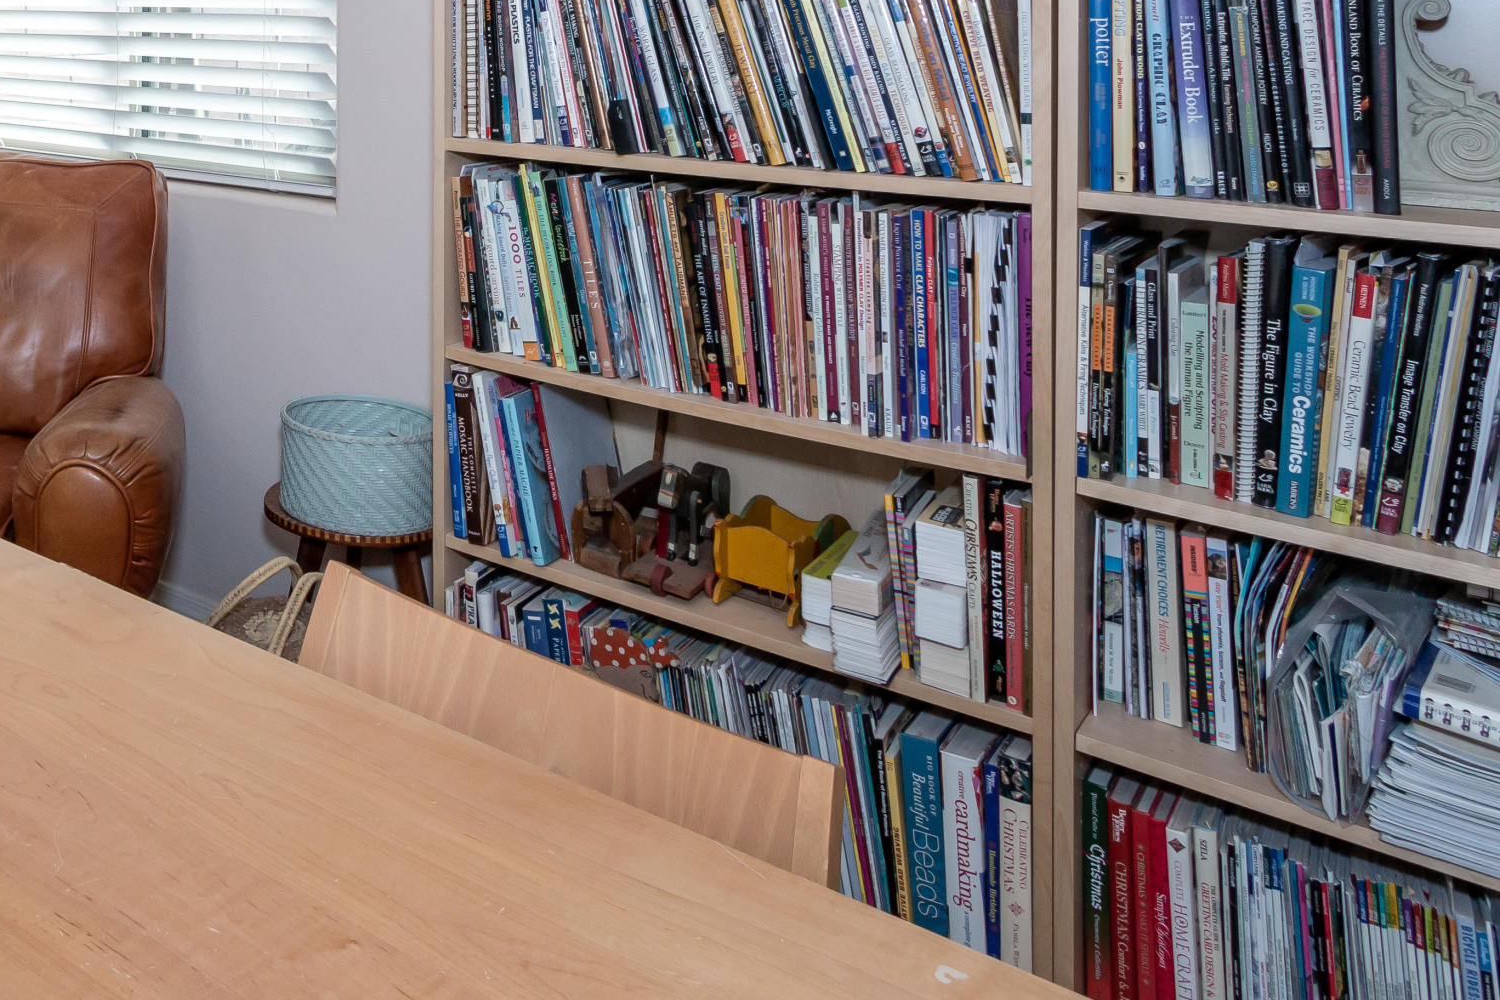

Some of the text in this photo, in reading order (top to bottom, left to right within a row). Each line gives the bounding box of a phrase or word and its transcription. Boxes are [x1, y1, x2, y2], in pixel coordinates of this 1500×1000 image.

[509, 4, 521, 44] PLASTICS
[790, 9, 805, 36] Precious
[800, 37, 812, 54] Metal
[804, 55, 817, 69] Clay
[1090, 17, 1111, 67] potter
[1152, 33, 1168, 126] GRAPHIC CLAY
[1179, 22, 1202, 124] Extruder Book
[485, 243, 502, 306] gourd carving
[508, 225, 526, 298] 1000 TILES
[694, 254, 713, 343] THE ART OF ENAMELING
[1260, 319, 1281, 424] The Figure in Clay
[1341, 340, 1365, 452] Ceramic Bead Jewelry
[1392, 359, 1419, 454] Image Transfer on Clay
[457, 417, 473, 513] MOSAIC HANDBOOK
[543, 448, 558, 500] HANDMADE BOOKS
[1288, 395, 1311, 474] Ceramics
[990, 550, 1004, 640] HALLOWEEN
[1155, 524, 1171, 653] RETIREMENT CHOICES Howells
[910, 772, 944, 920] Beautiful Beads
[953, 770, 977, 912] creative cardmaking
[1002, 807, 1018, 894] CHRISTMAS
[1018, 819, 1030, 890] CELEBRATING
[1084, 844, 1106, 911] Christmas
[1115, 861, 1130, 978] CHRISTMAS Comfort
